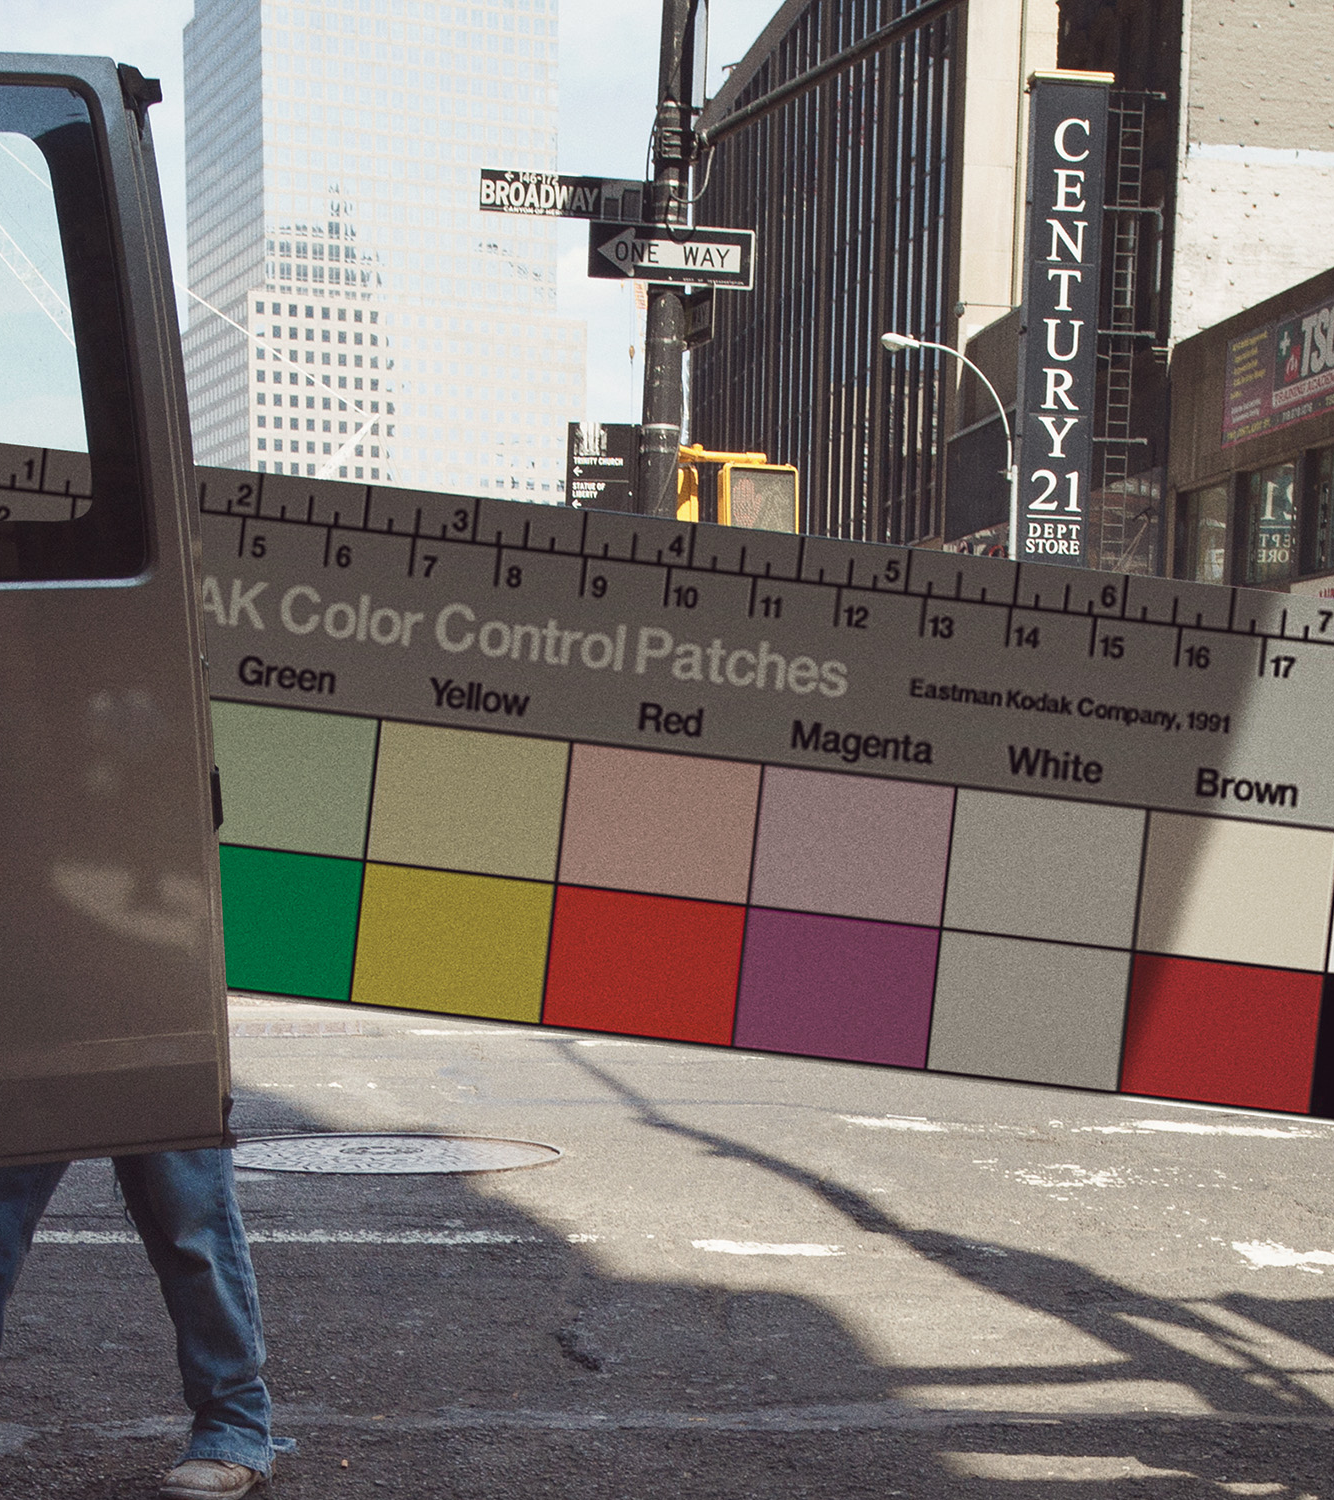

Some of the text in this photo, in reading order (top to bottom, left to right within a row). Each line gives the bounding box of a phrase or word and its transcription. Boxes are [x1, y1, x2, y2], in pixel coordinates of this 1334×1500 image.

[480, 179, 599, 212] BROADWAY
[615, 240, 731, 269] ONE WAY
[1040, 118, 1092, 458] CENTURY
[573, 456, 624, 467] TRINITY CHURCH
[572, 481, 606, 491] STATUE OF
[572, 490, 598, 499] LIBERTY
[1028, 470, 1082, 513] 21
[24, 458, 1333, 632] 1 2 3 4 5 6 7
[1025, 538, 1081, 556] STORE
[1028, 522, 1081, 540] DEPT
[250, 536, 267, 560] 5
[335, 545, 352, 569] 6
[422, 555, 438, 578] 7
[505, 565, 522, 589] 8
[591, 575, 608, 599] 9
[673, 586, 698, 609] 10
[760, 596, 783, 619] 11
[844, 605, 869, 628] 12
[928, 616, 955, 638] 13
[1014, 625, 1040, 648] 14
[1098, 636, 1125, 659] 15
[1184, 645, 1211, 669] 16
[1270, 655, 1296, 678] 17
[280, 585, 422, 647] Color
[435, 605, 625, 673] Control
[636, 626, 848, 697] Patches
[909, 677, 1232, 734] Eastman Kodak Company, 1991
[237, 656, 337, 695] Green
[429, 677, 530, 718] Yellow
[638, 702, 704, 738] Red
[791, 719, 933, 767] Magenta
[1008, 744, 1104, 784] White
[1196, 766, 1299, 808] Brown
